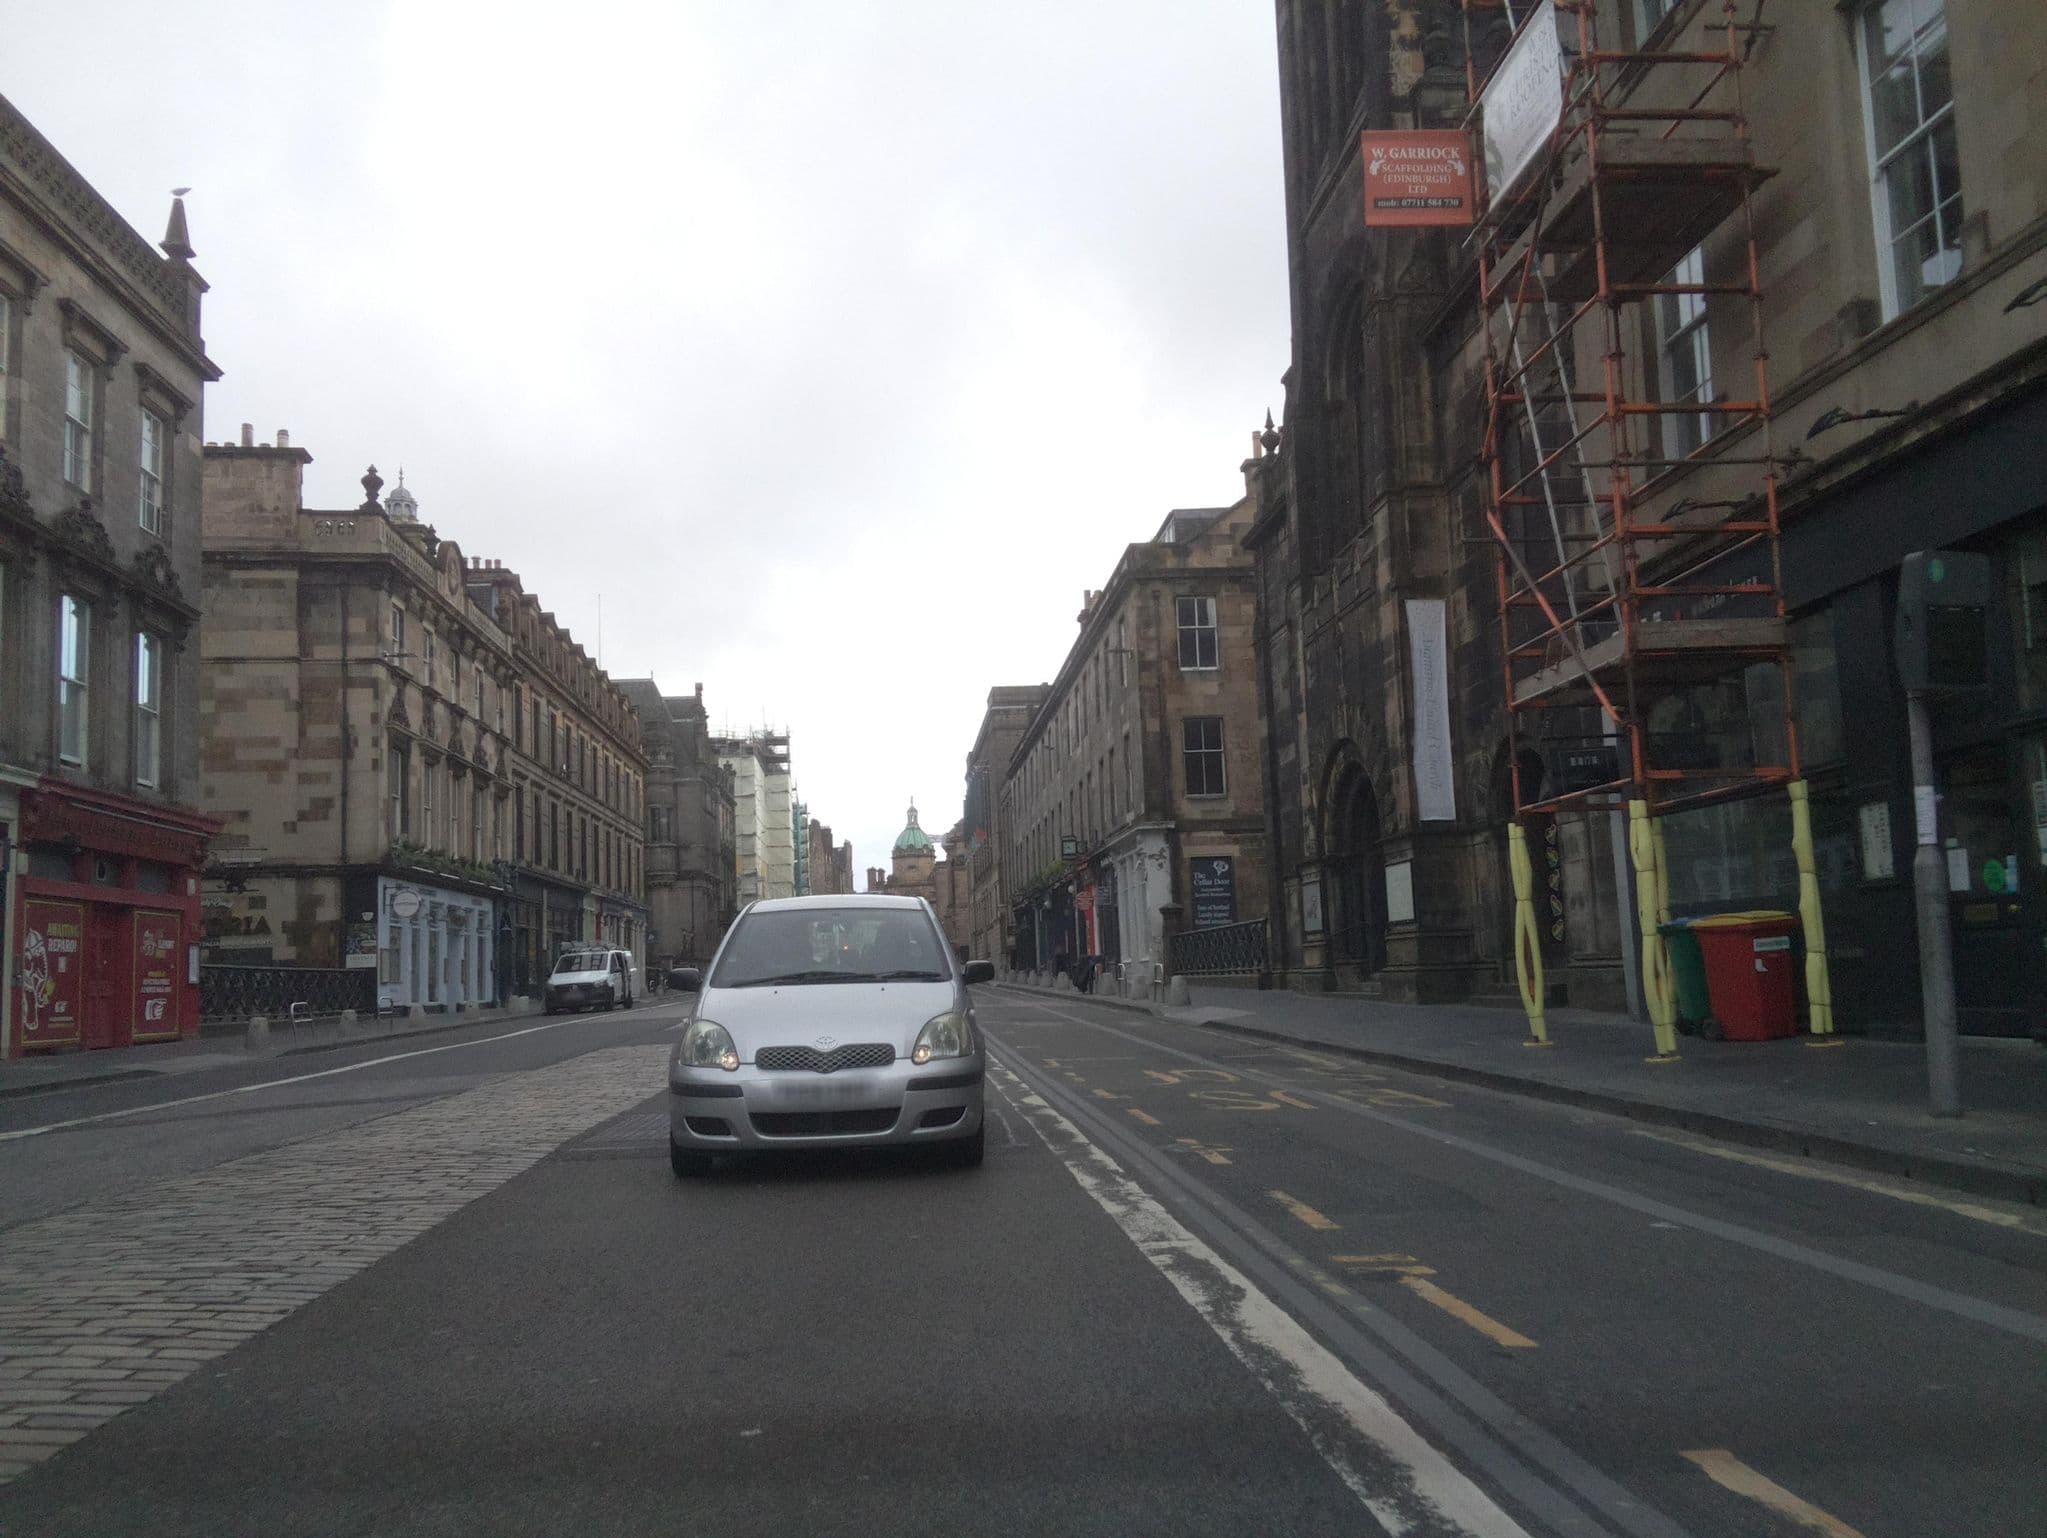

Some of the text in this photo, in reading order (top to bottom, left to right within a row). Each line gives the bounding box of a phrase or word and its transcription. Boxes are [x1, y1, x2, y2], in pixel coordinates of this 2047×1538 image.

[1371, 147, 1460, 159] W. GARRIOCK
[1382, 163, 1452, 173] SCAFFOLDING
[1383, 174, 1451, 184] (EDINBURGH)
[1408, 185, 1428, 194] LTD
